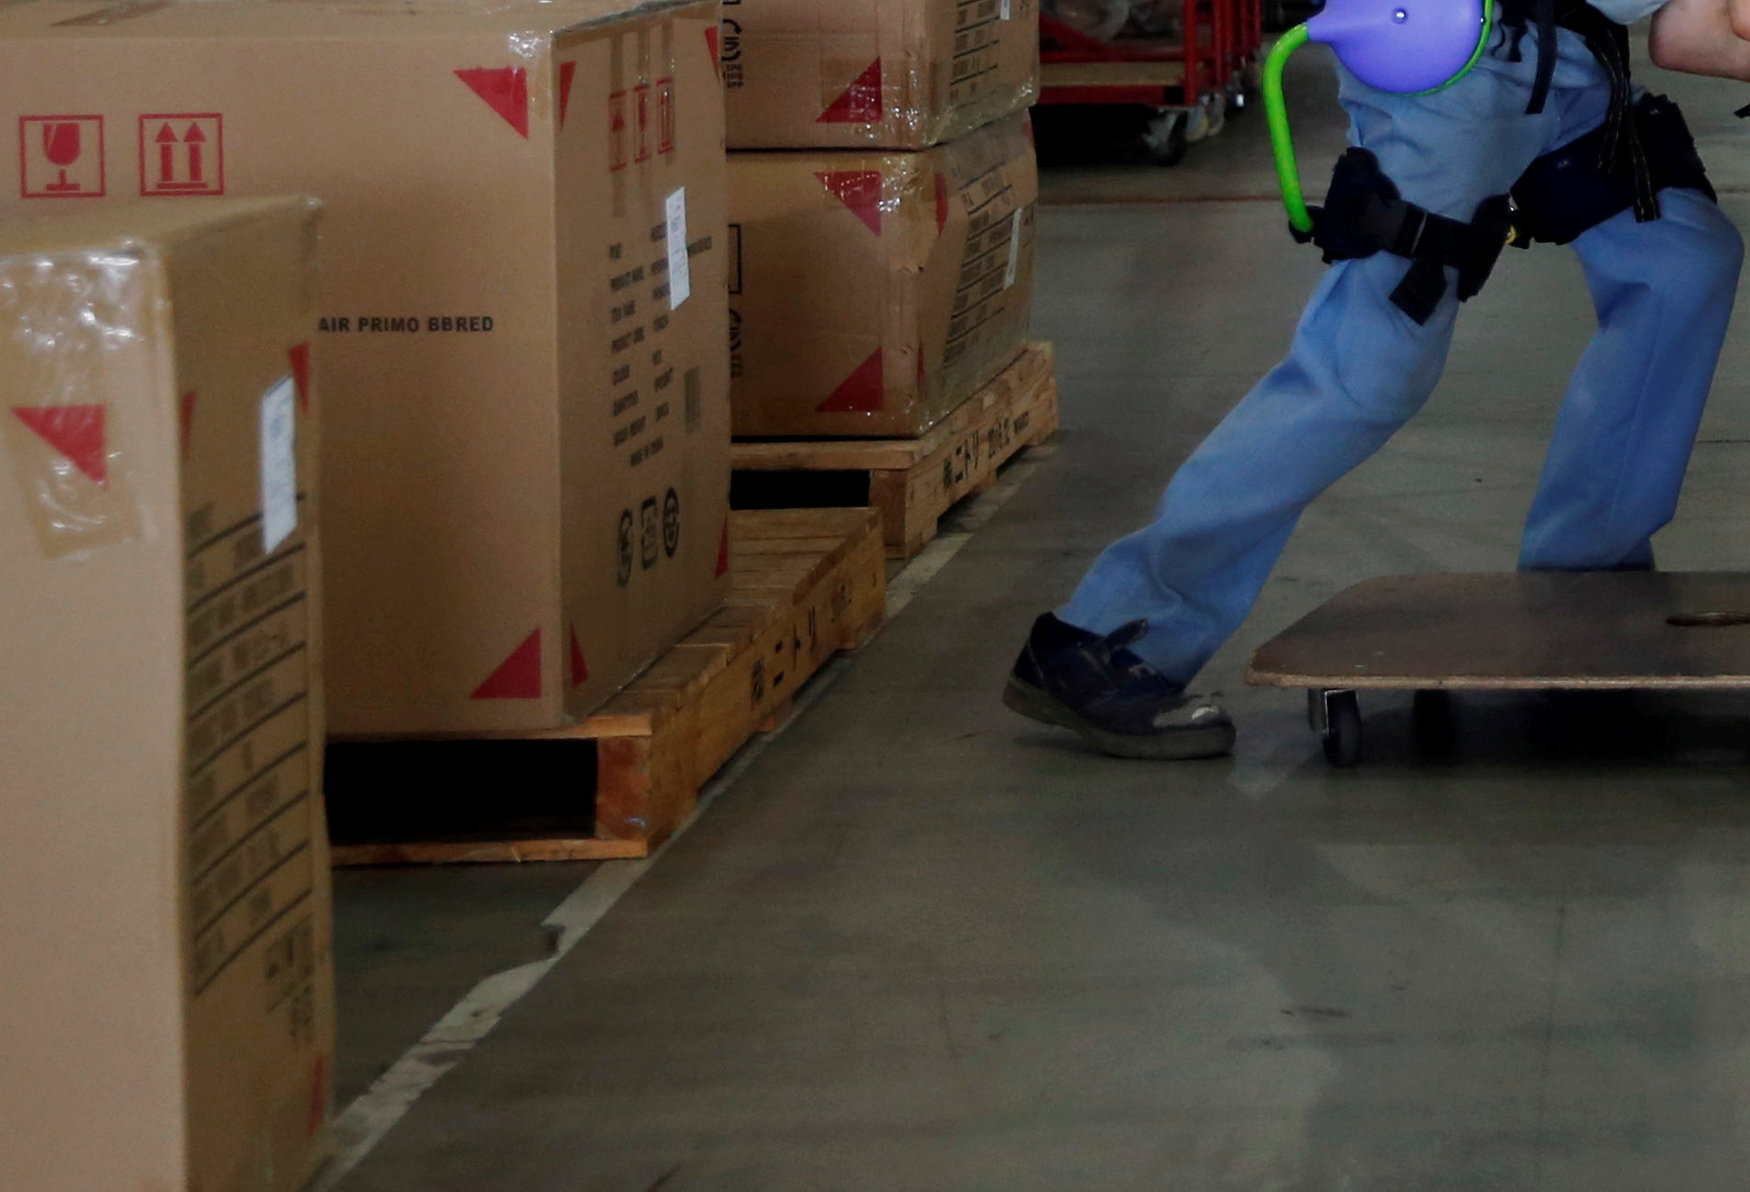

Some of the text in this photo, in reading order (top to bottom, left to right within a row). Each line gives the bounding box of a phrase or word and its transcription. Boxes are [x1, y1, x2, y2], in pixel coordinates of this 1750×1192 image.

[318, 315, 494, 333] AIR PRIMO BBRED
